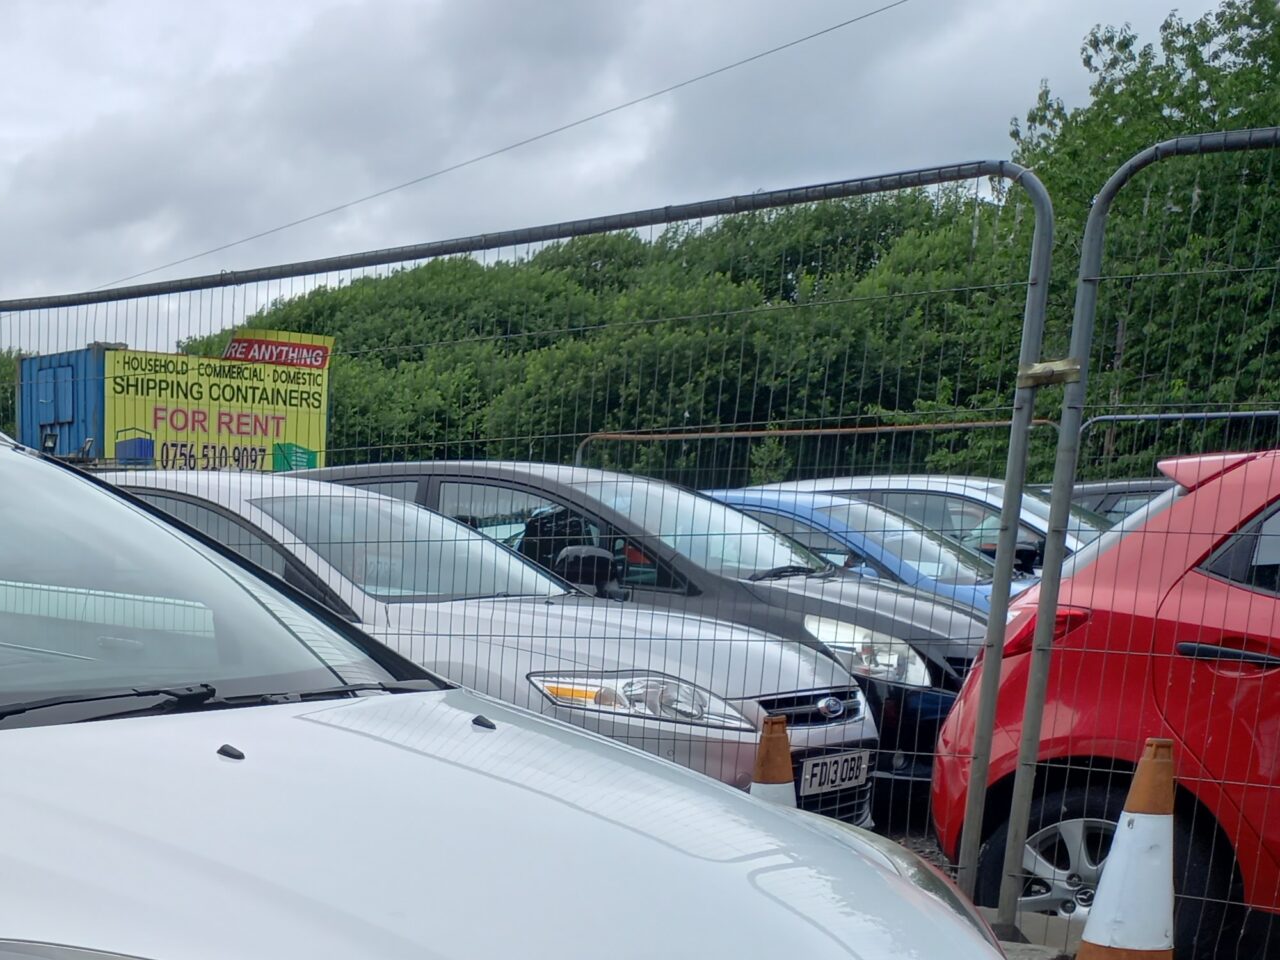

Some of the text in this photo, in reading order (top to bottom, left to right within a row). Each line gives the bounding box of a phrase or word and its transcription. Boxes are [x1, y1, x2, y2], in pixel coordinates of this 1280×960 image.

[248, 343, 323, 366] ANYTHING
[123, 355, 322, 387] HOUSEHOLD COMMERCIAL DOMESTIC
[113, 376, 321, 409] SHIPPING CONTAINERS
[153, 408, 285, 438] FOR RENT
[161, 442, 196, 470] 0756
[809, 760, 839, 788] FD13
